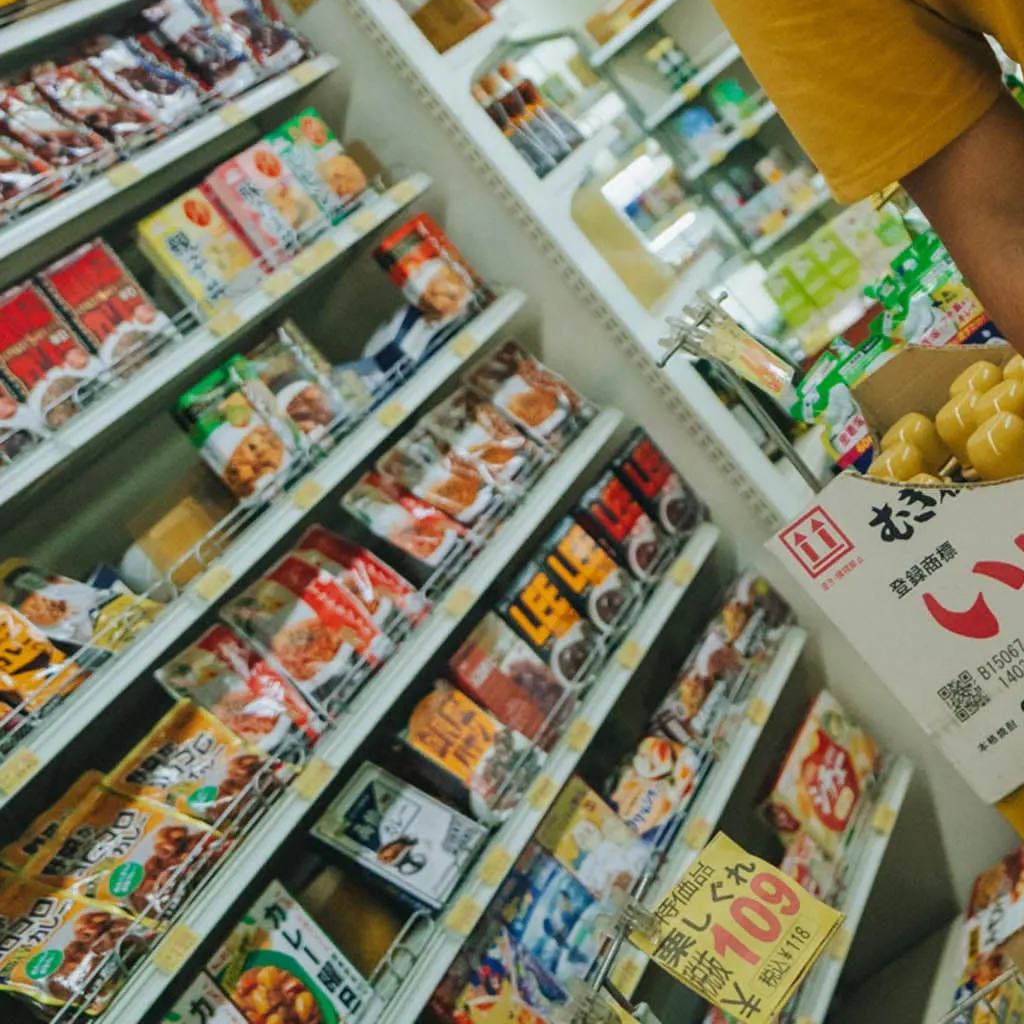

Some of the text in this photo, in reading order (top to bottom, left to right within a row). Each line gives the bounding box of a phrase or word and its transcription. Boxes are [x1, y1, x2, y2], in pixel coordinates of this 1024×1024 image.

[889, 540, 958, 599] 登録商標
[509, 572, 572, 645] LEE
[28, 902, 71, 944] カレー
[711, 872, 801, 967] 109
